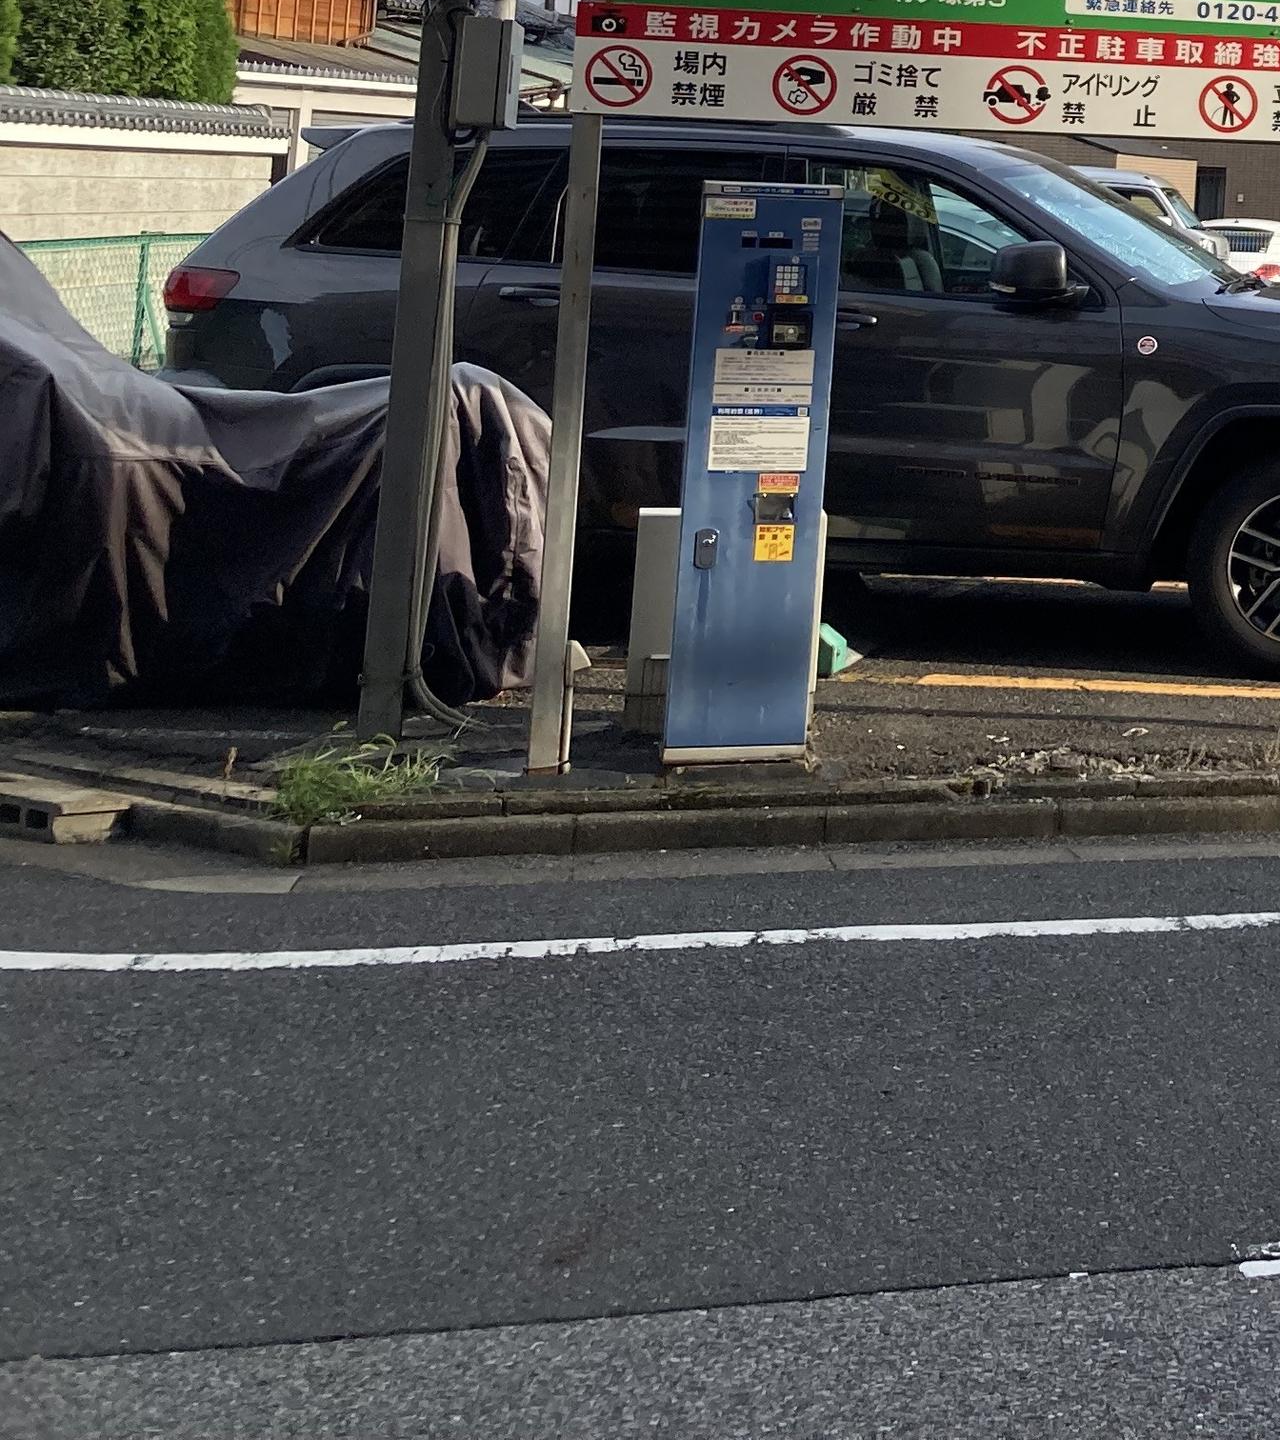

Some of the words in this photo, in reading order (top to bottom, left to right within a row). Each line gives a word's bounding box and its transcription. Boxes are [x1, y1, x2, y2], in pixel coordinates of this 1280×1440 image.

[644, 11, 962, 52] 監視カメラ作動中
[673, 50, 727, 77] 場内
[853, 62, 942, 90] ゴミ捨て
[671, 80, 725, 109] 禁煙
[1062, 71, 1161, 99] アイドリング
